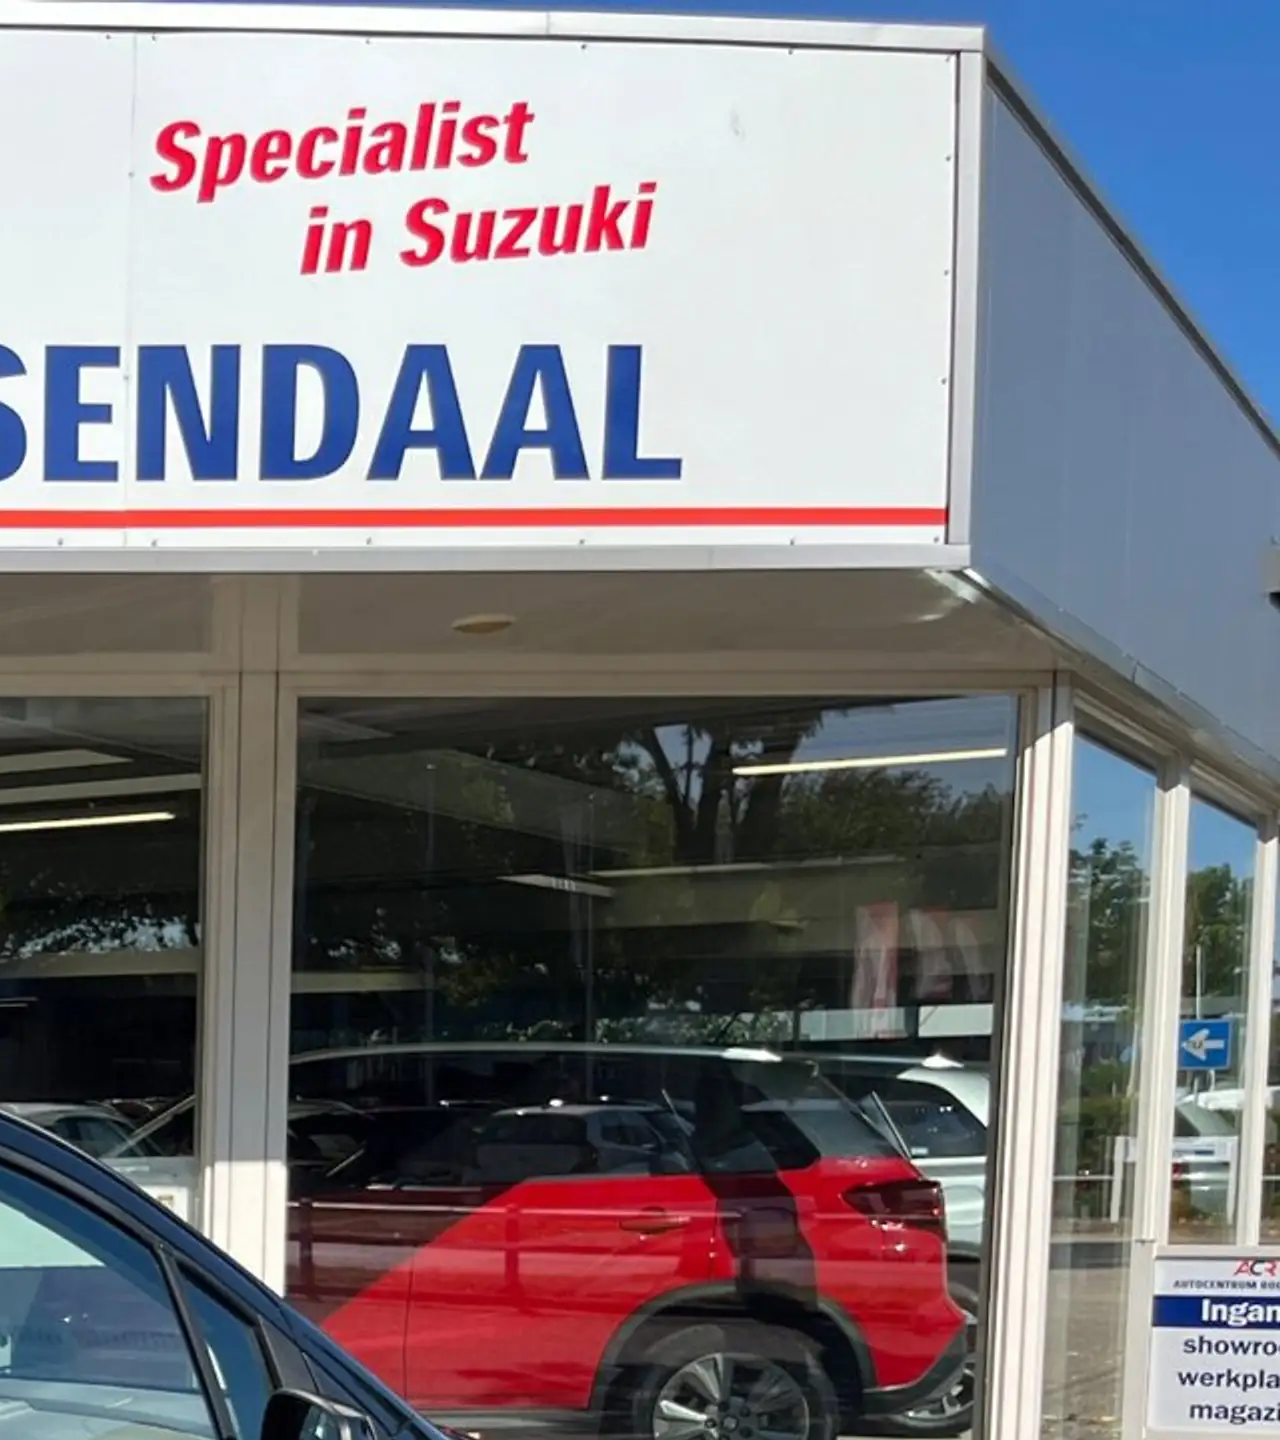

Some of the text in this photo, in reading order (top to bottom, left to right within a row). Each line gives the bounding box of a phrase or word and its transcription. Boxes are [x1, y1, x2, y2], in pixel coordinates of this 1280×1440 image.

[150, 101, 534, 203] Specialist
[300, 182, 657, 275] in Suzuki
[1234, 1258, 1278, 1277] ACR
[1173, 1279, 1257, 1290] AUTOCENTRUM
[1183, 1335, 1280, 1356] showro
